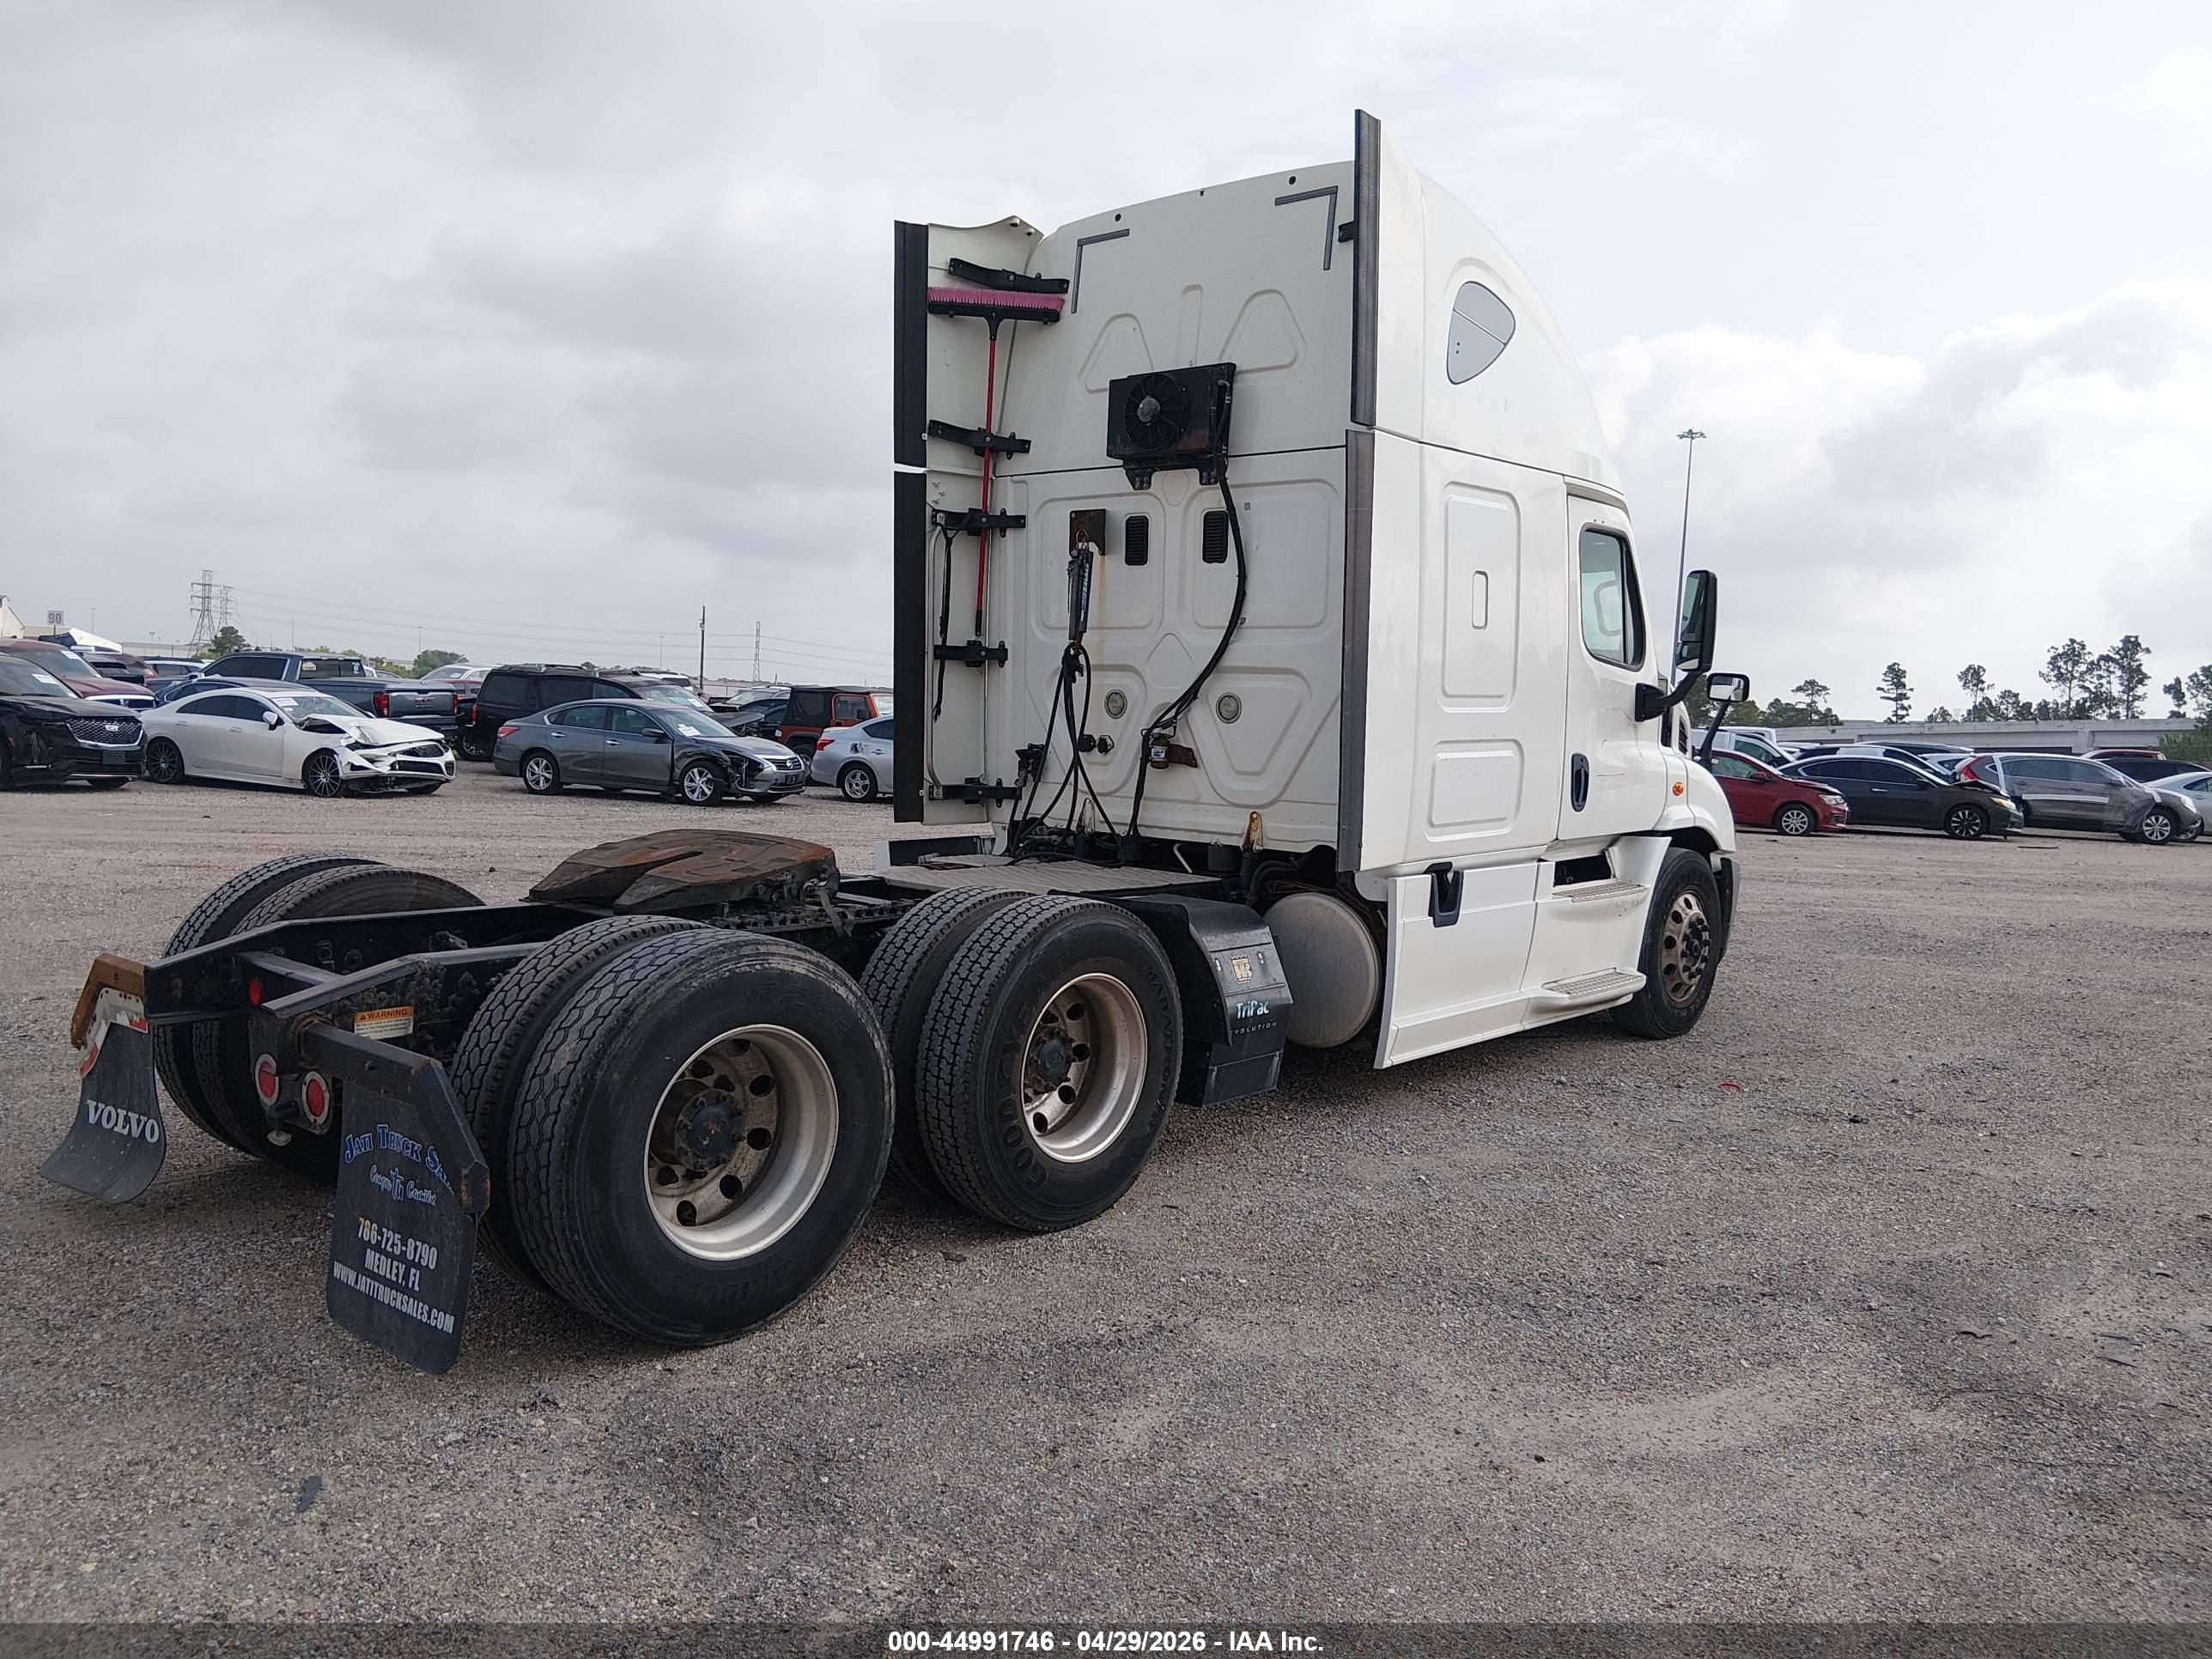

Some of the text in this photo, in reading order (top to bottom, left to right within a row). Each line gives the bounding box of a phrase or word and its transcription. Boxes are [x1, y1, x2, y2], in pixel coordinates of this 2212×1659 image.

[368, 1008, 408, 1020] WARNING
[1237, 1000, 1270, 1019] TriPac
[86, 1099, 159, 1143] VOLVO
[377, 1124, 422, 1162] TRUCK
[357, 1217, 438, 1270] 786-725-8790
[365, 1249, 421, 1292] MEDLEY, FL
[333, 1261, 455, 1334] WWW.JATITRUCKSALES.COM
